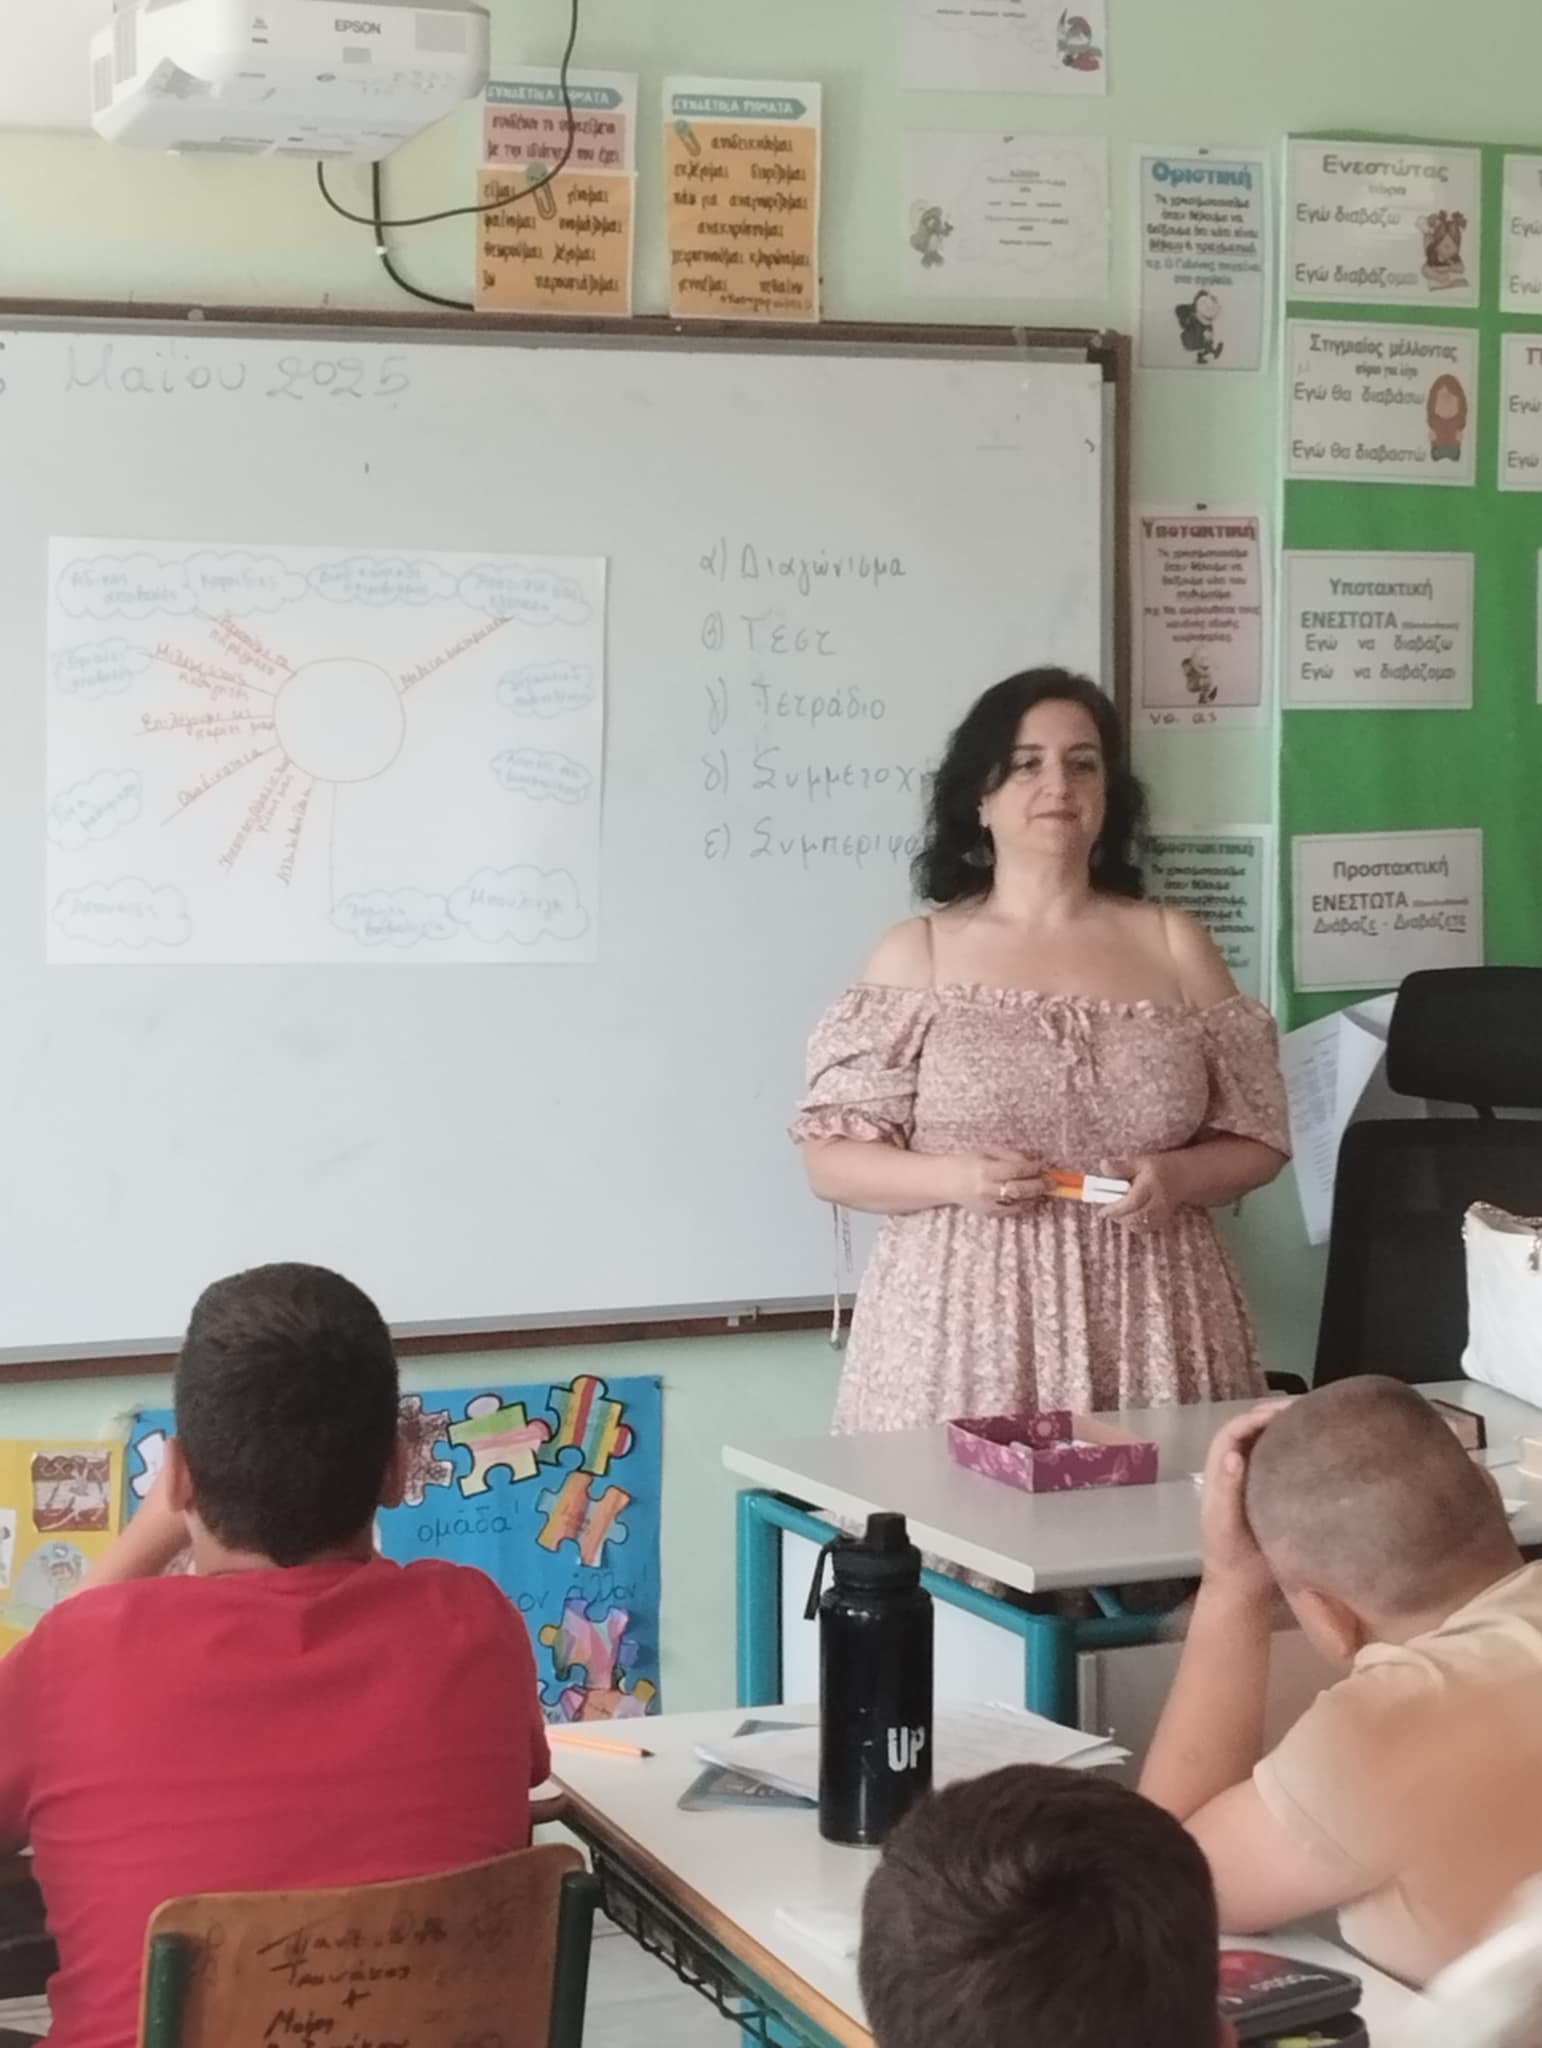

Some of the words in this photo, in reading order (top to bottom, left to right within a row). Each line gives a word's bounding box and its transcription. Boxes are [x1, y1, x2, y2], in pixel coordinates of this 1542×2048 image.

[334, 19, 382, 35] EPSON
[1151, 160, 1253, 191] Οριστική
[1322, 153, 1449, 183] Ενεστώτας
[1296, 202, 1331, 224] Εγώ
[1334, 205, 1401, 229] διαβάζω
[1295, 262, 1329, 285] Εγώ
[1389, 338, 1458, 363] μέλλοντας
[265, 355, 411, 399] 2025
[1294, 381, 1328, 403] Εγώ
[1331, 383, 1353, 402] θα
[1507, 395, 1541, 414] Εγώ
[1292, 439, 1326, 460] Εγώ
[1330, 442, 1351, 460] θα
[1506, 451, 1540, 471] Εγώ
[741, 543, 907, 598] Διαγώνισμα
[1329, 577, 1433, 602] Υποτακτική
[1300, 610, 1399, 630] ΕΝΕΣΤΩΤΑ
[1305, 633, 1338, 652] Εγώ
[1357, 638, 1376, 651] να
[1394, 633, 1453, 654] διαβάζω
[1300, 662, 1334, 681] Εγώ
[1353, 666, 1371, 679] να
[750, 682, 886, 729] Τετράδιο
[1332, 854, 1449, 882] Προστακτική
[1311, 891, 1409, 913] ΕΝΕΣΤΩΤΑ
[886, 1726, 926, 1773] UP
